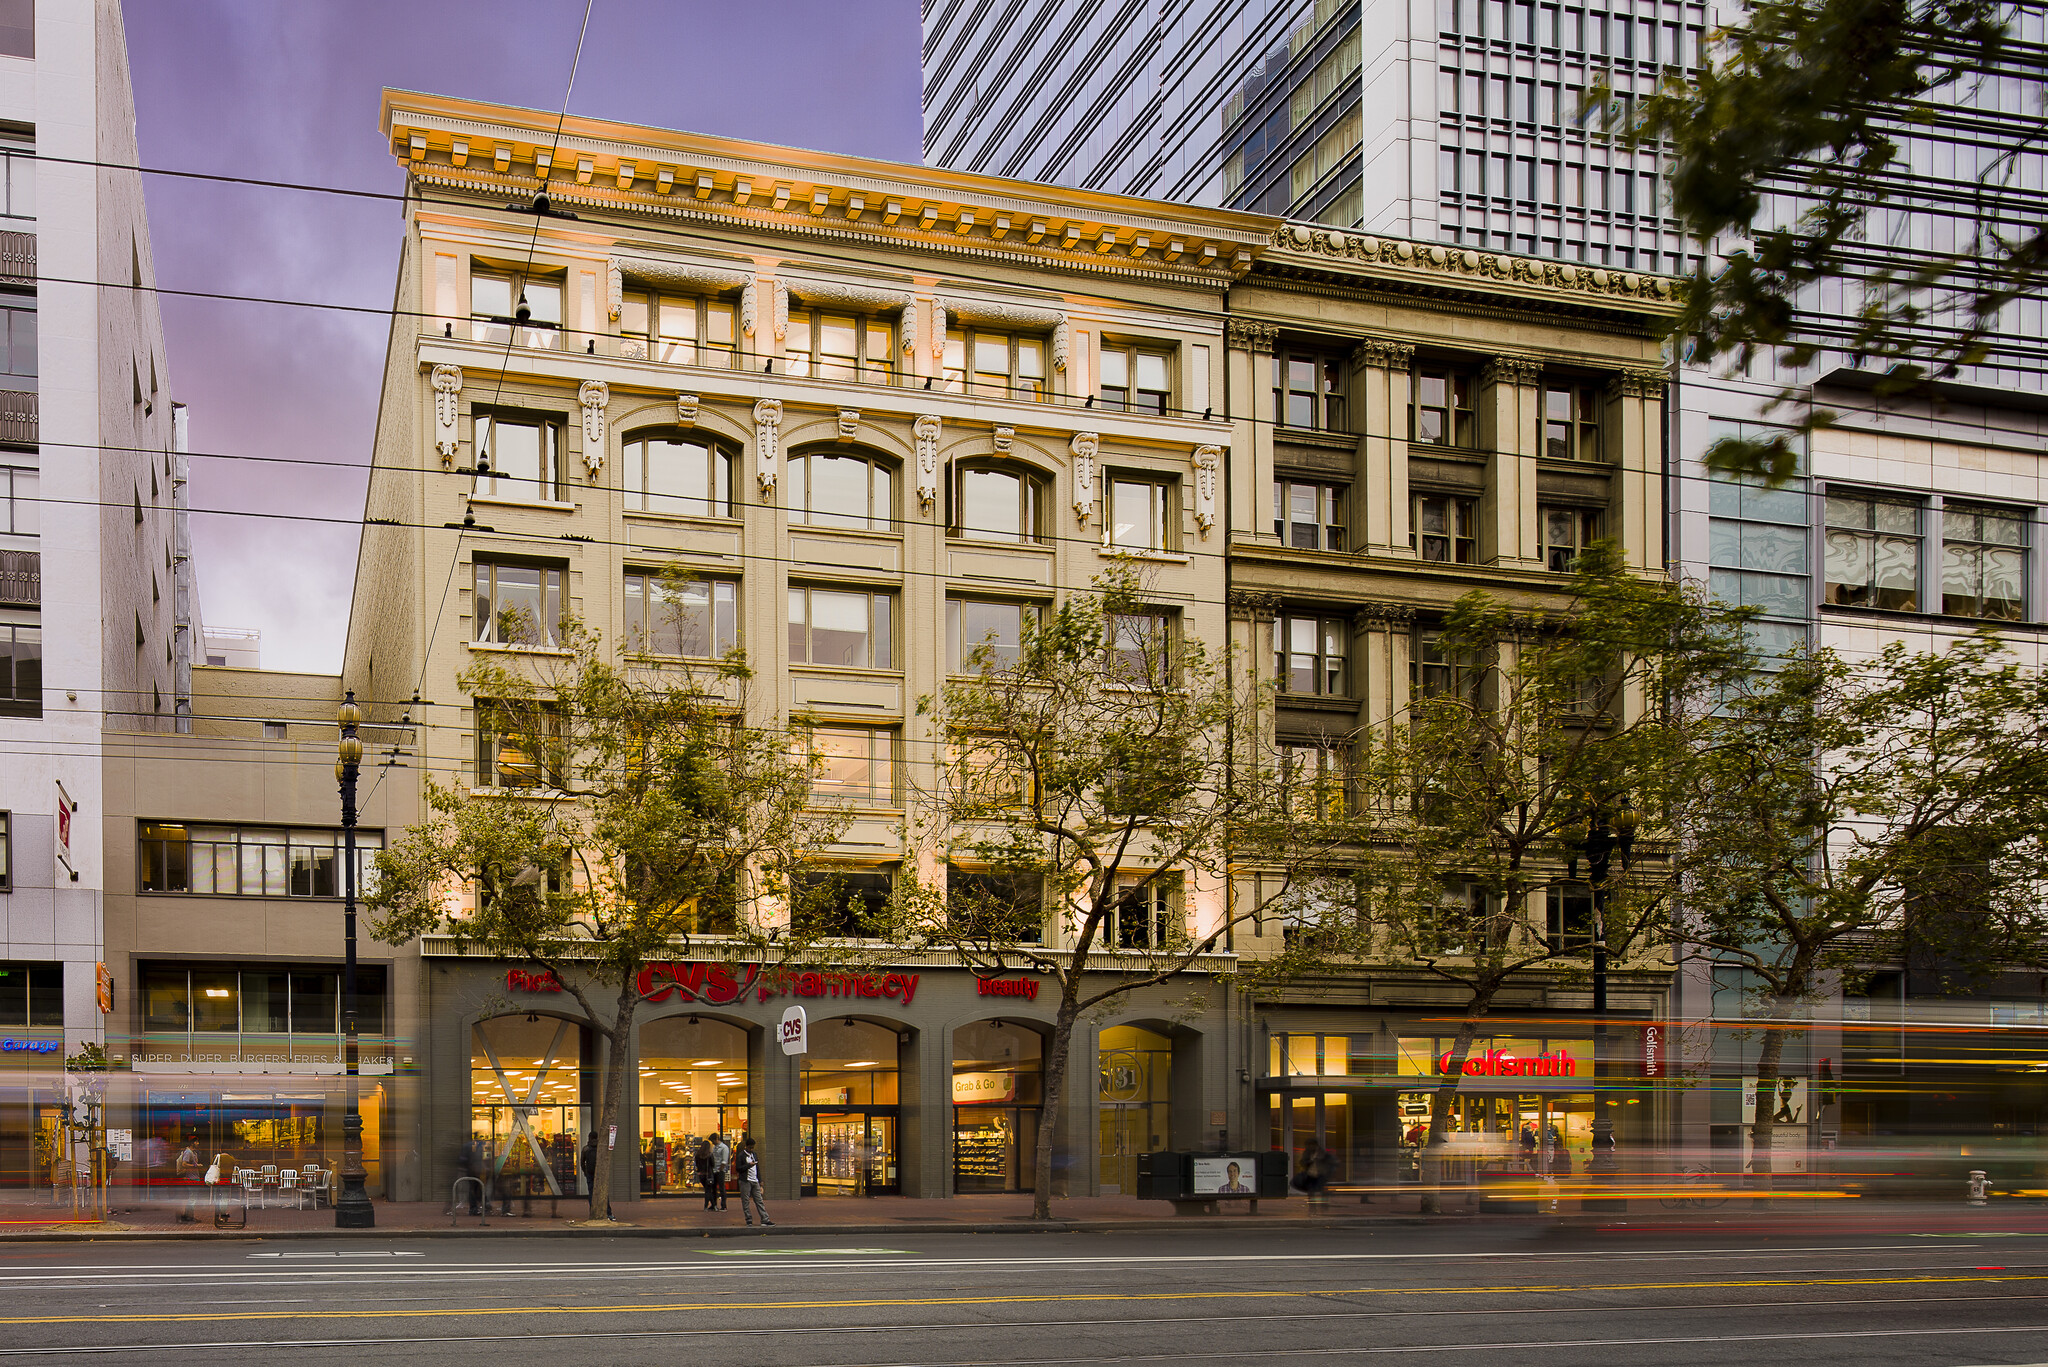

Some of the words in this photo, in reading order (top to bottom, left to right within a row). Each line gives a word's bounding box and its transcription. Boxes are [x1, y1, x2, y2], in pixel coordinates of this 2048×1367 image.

[977, 974, 1040, 1000] Beauty
[783, 1018, 801, 1037] CVS
[1, 1037, 58, 1053] Garage
[783, 1035, 801, 1046] pharmacy
[132, 1053, 173, 1064] SUPER
[180, 1053, 222, 1064] DUPER
[230, 1054, 287, 1065] BURGERS
[294, 1054, 328, 1065] FRIES
[1646, 1026, 1658, 1076] Golfsmith
[955, 1080, 974, 1093] Grab
[975, 1079, 982, 1091] &
[983, 1078, 995, 1090] Go
